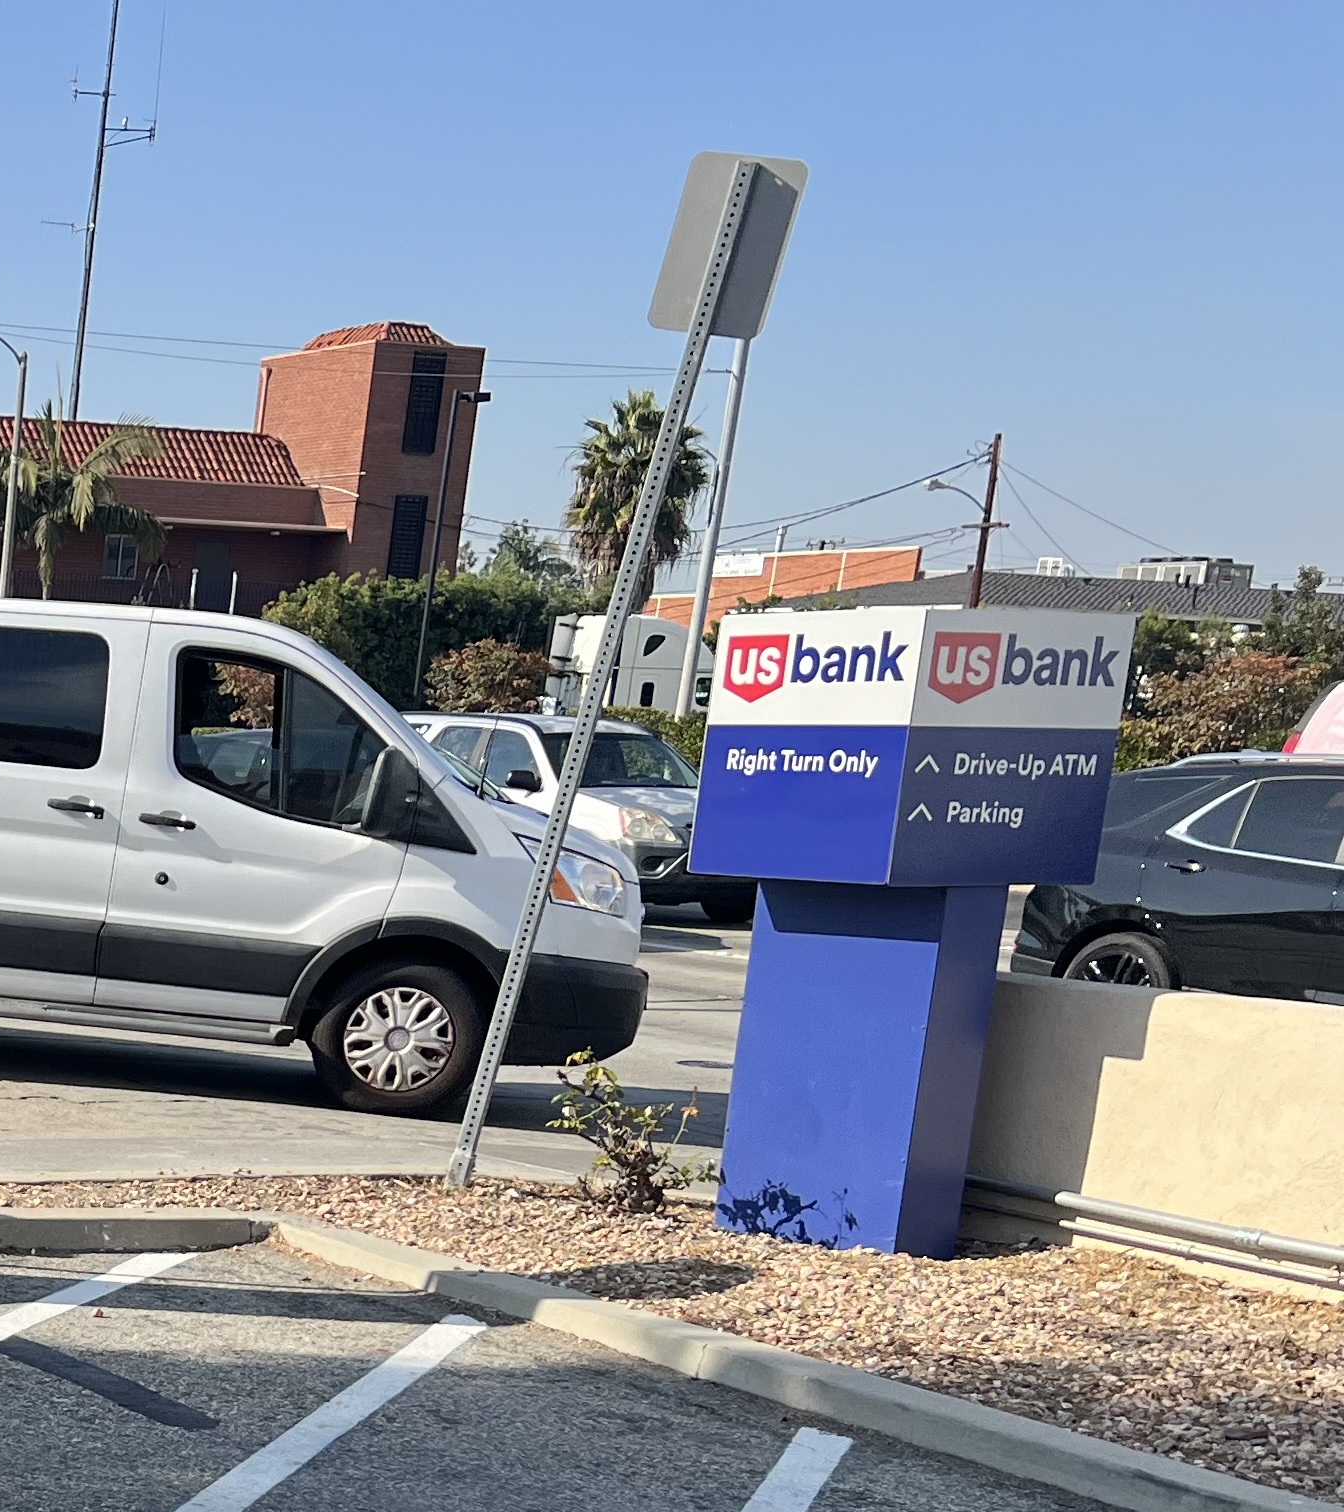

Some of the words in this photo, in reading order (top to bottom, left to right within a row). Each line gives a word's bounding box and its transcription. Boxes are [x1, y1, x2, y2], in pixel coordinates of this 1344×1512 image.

[729, 647, 781, 686] us
[790, 631, 910, 684] bank
[935, 644, 992, 686] us
[1002, 634, 1120, 688] bank
[726, 748, 777, 776] Right
[781, 749, 824, 773] Turn
[829, 749, 879, 778] Only
[954, 753, 1047, 781] Drive-Up
[1049, 754, 1098, 777] ATM
[947, 801, 1025, 830] Parking
